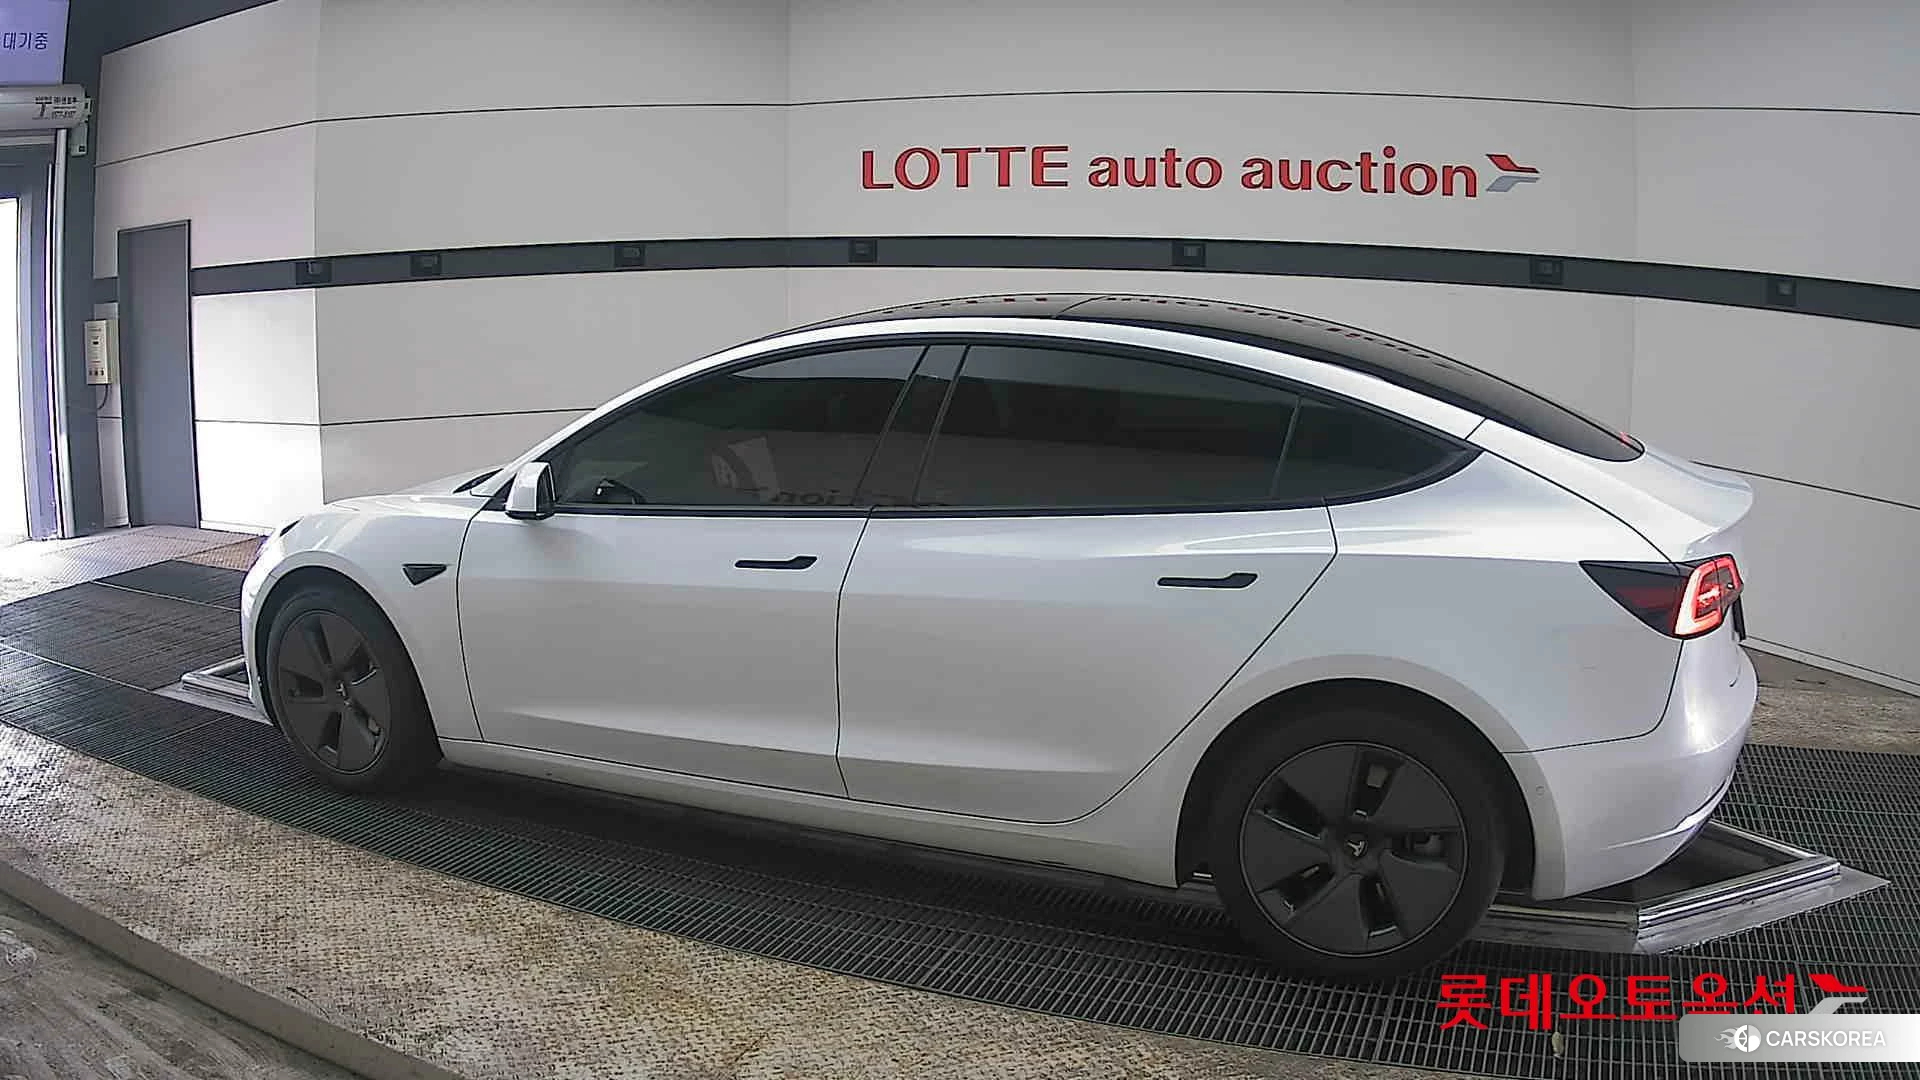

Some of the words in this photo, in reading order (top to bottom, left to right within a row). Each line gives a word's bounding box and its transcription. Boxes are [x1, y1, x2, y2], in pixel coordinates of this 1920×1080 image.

[2, 31, 48, 50] 대기중
[862, 146, 1069, 190] LOTTE
[1088, 148, 1223, 188] auto
[1241, 146, 1478, 197] auction
